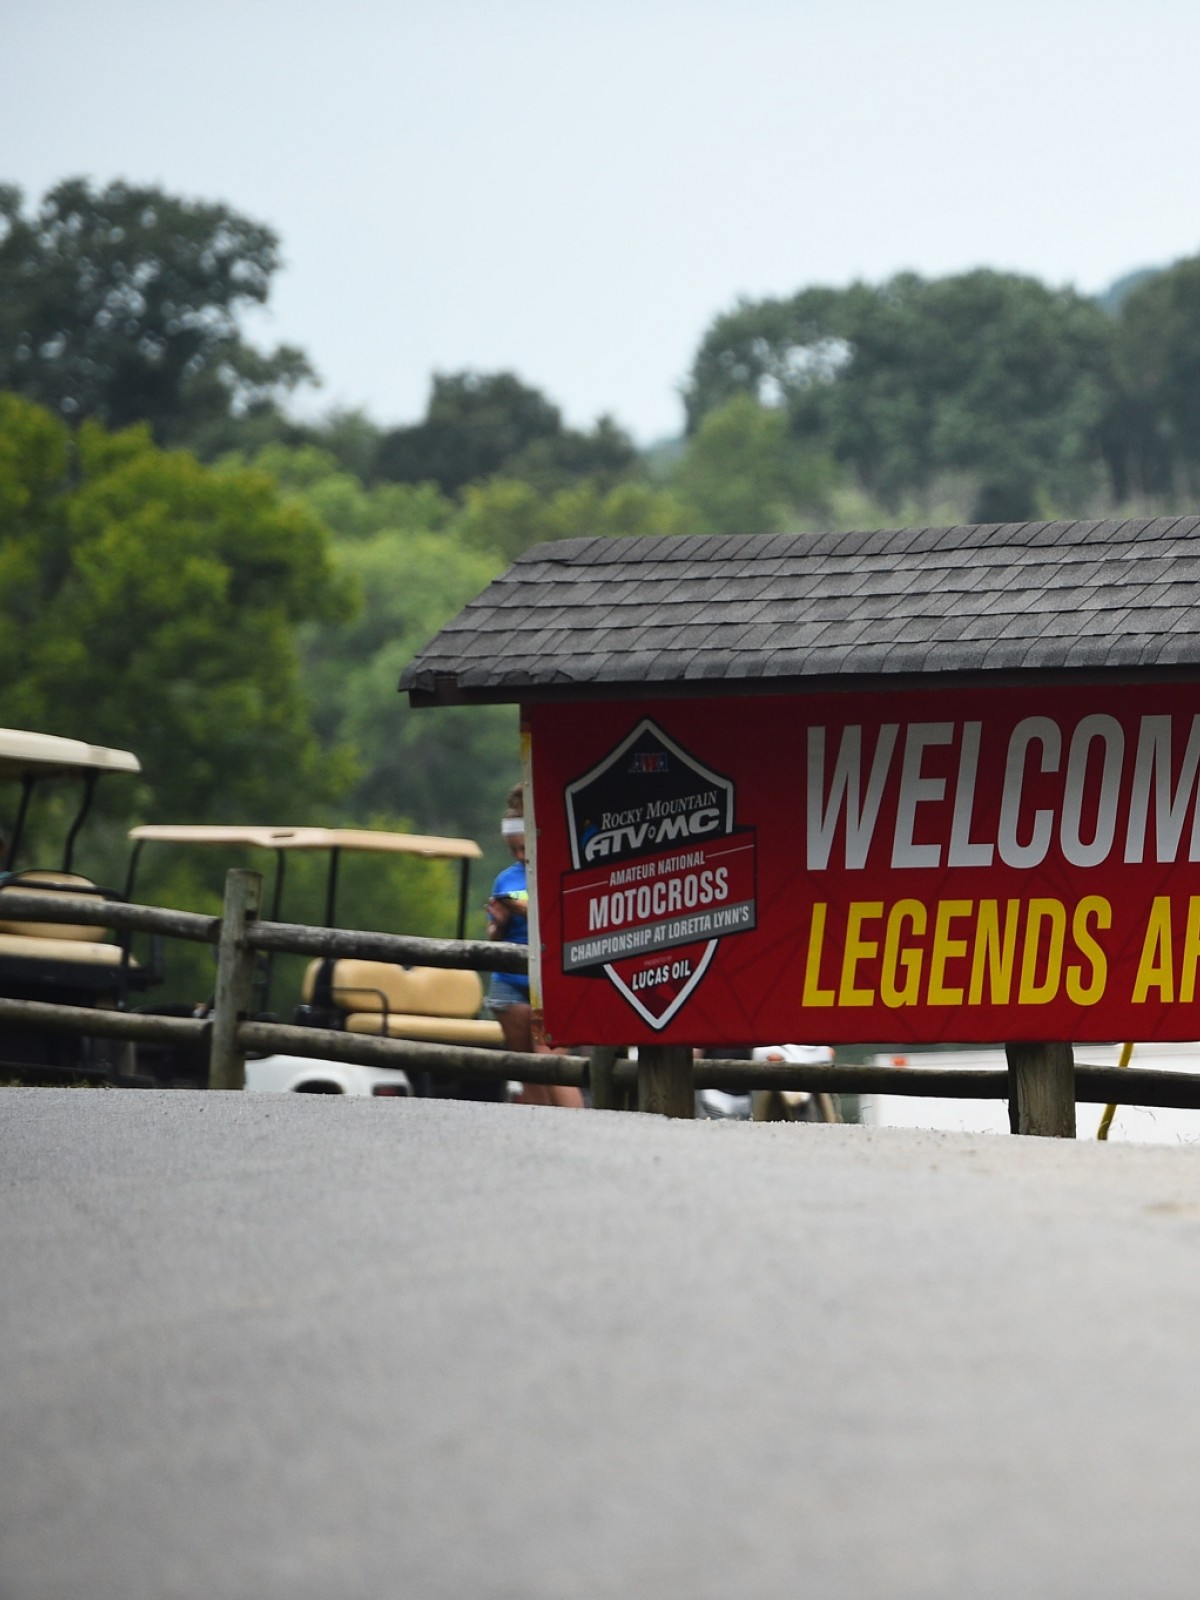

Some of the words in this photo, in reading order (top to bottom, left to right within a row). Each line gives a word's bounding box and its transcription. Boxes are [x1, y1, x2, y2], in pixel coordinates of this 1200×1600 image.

[601, 808, 643, 830] ROCKY
[646, 790, 718, 819] MOUNTAIN
[609, 863, 655, 887] AMATEUR
[658, 851, 706, 875] NATIONAL
[589, 867, 728, 931] MOTOCROSS
[570, 929, 651, 962] CHAMPIONSHIP
[654, 925, 666, 942] AT
[668, 916, 711, 939] LORETTA
[713, 906, 749, 928] LYNN'S
[802, 895, 1112, 1008] LEGENDS
[632, 965, 669, 990] LUCAS
[672, 959, 691, 979] OIL
